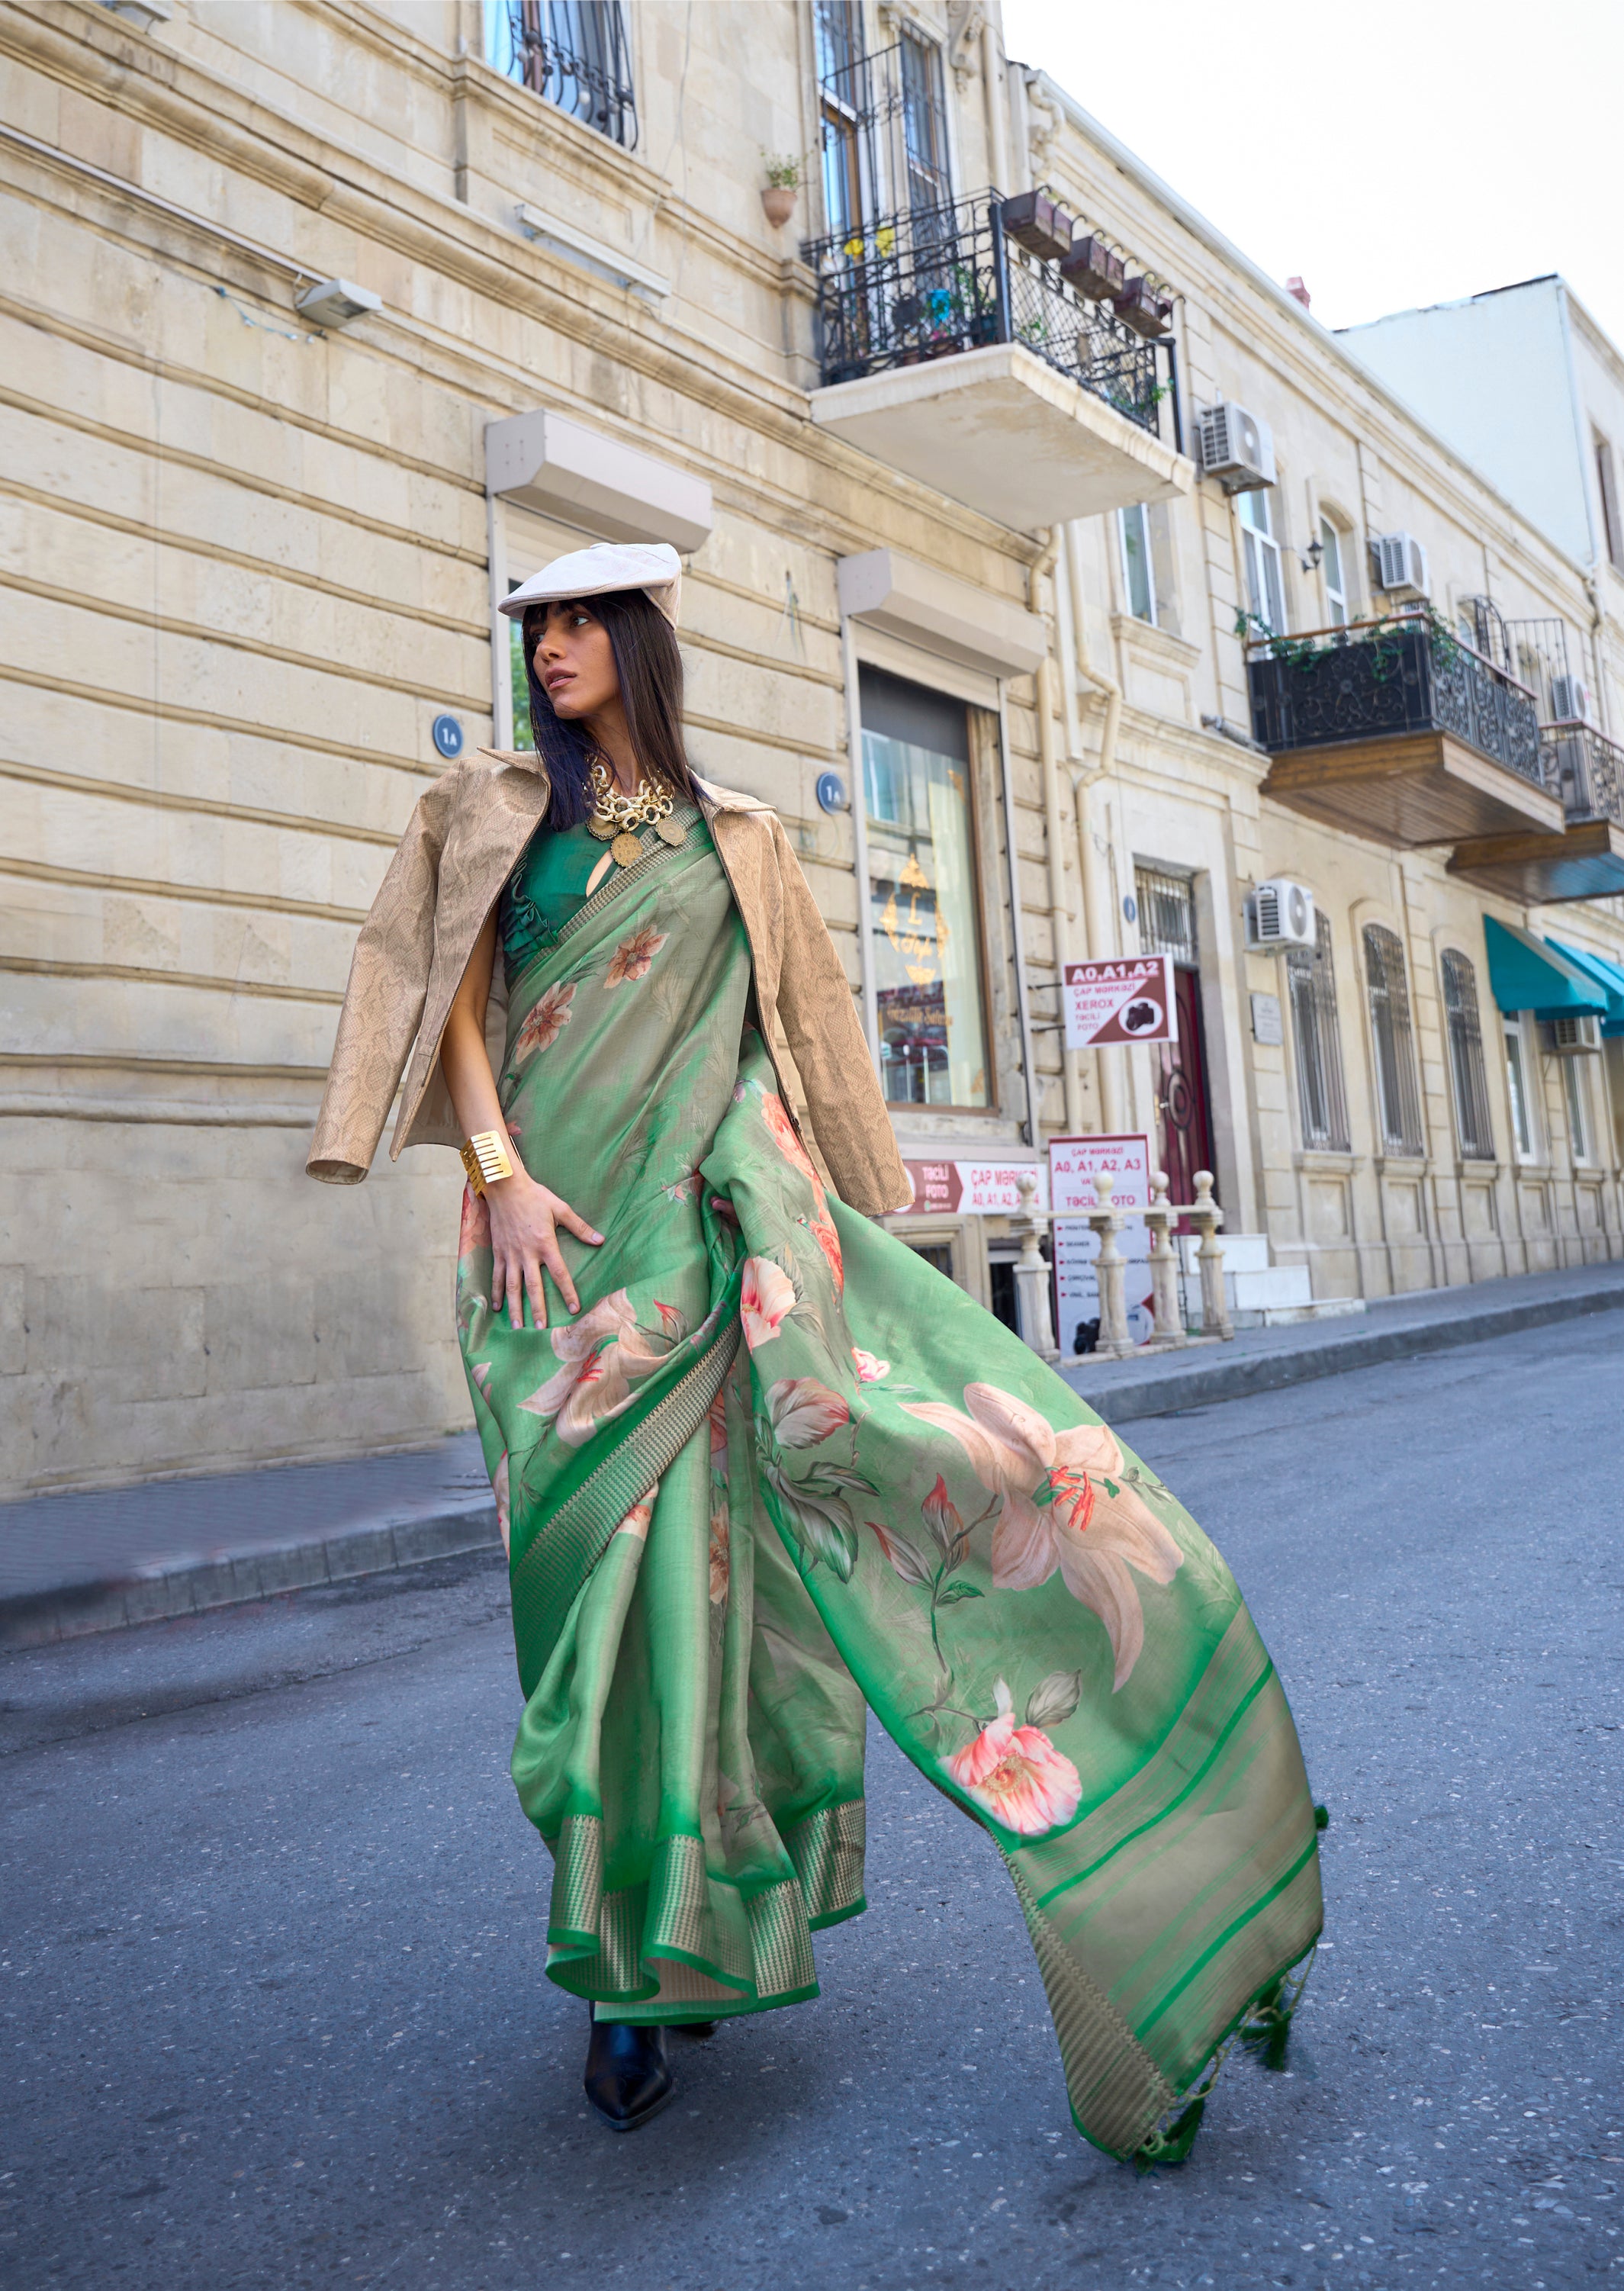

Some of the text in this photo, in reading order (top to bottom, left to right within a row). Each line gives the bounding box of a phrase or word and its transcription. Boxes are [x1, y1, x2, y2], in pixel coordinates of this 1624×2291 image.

[442, 727, 458, 746] 1A
[1076, 999, 1114, 1011] XEROX
[1124, 1157, 1141, 1170] A3
[971, 1170, 991, 1189] ÇAP
[925, 1184, 949, 1199] FOTO
[1111, 1195, 1136, 1206] OTO
